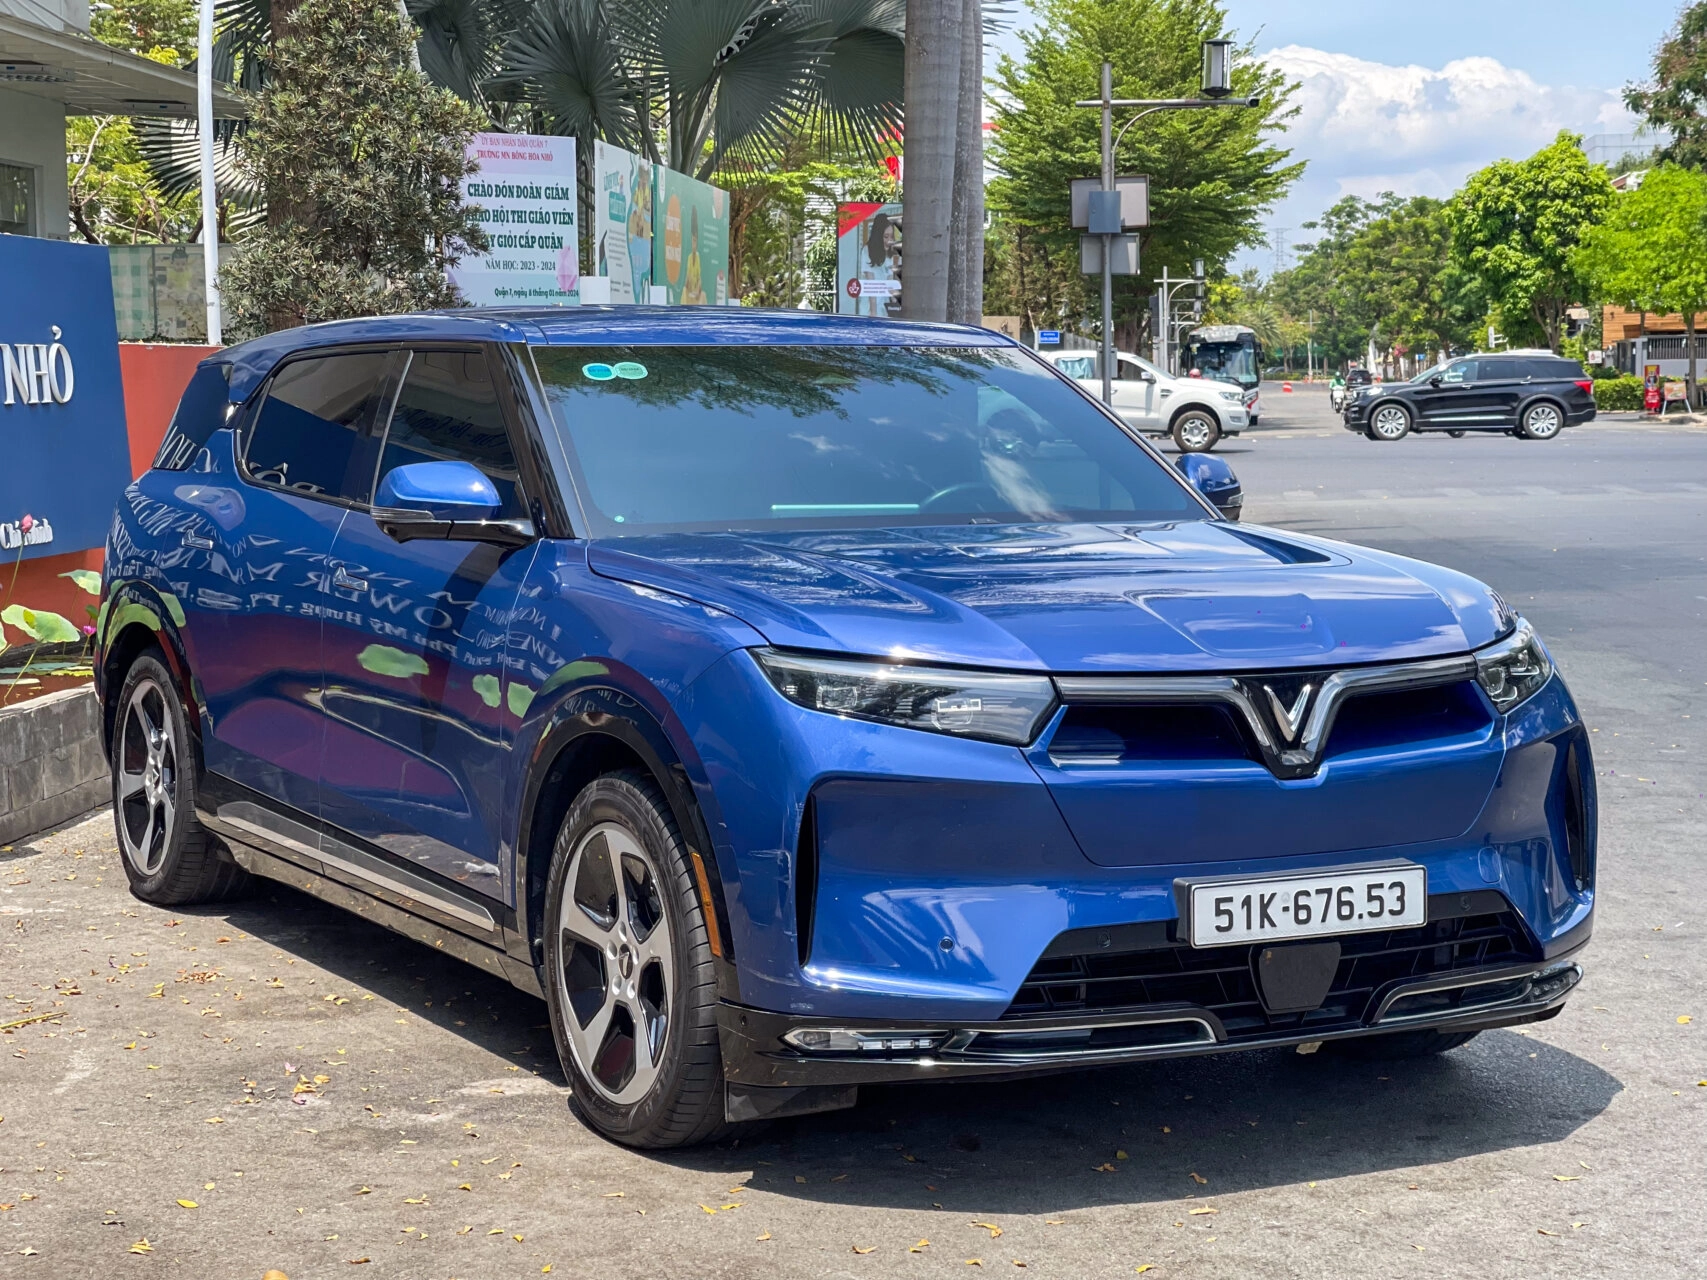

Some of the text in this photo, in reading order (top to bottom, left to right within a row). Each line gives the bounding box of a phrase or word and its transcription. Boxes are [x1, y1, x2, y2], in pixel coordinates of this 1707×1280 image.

[528, 152, 540, 160] HOA
[467, 179, 569, 200] CHÀO ĐÓN ĐOÀN GIÁM
[492, 205, 510, 227] HỘI
[510, 210, 527, 224] THI
[528, 206, 550, 225] GIÁO
[552, 207, 574, 225] VIÊN
[497, 230, 517, 248] GIỎI
[519, 229, 536, 248] CẤP
[538, 232, 563, 253] QUẬN
[485, 258, 500, 270] NĂM
[520, 260, 535, 271] 2023
[541, 261, 556, 271] 2024
[0, 325, 74, 405] NHỎ
[1214, 881, 1406, 933] 51K-676.53
